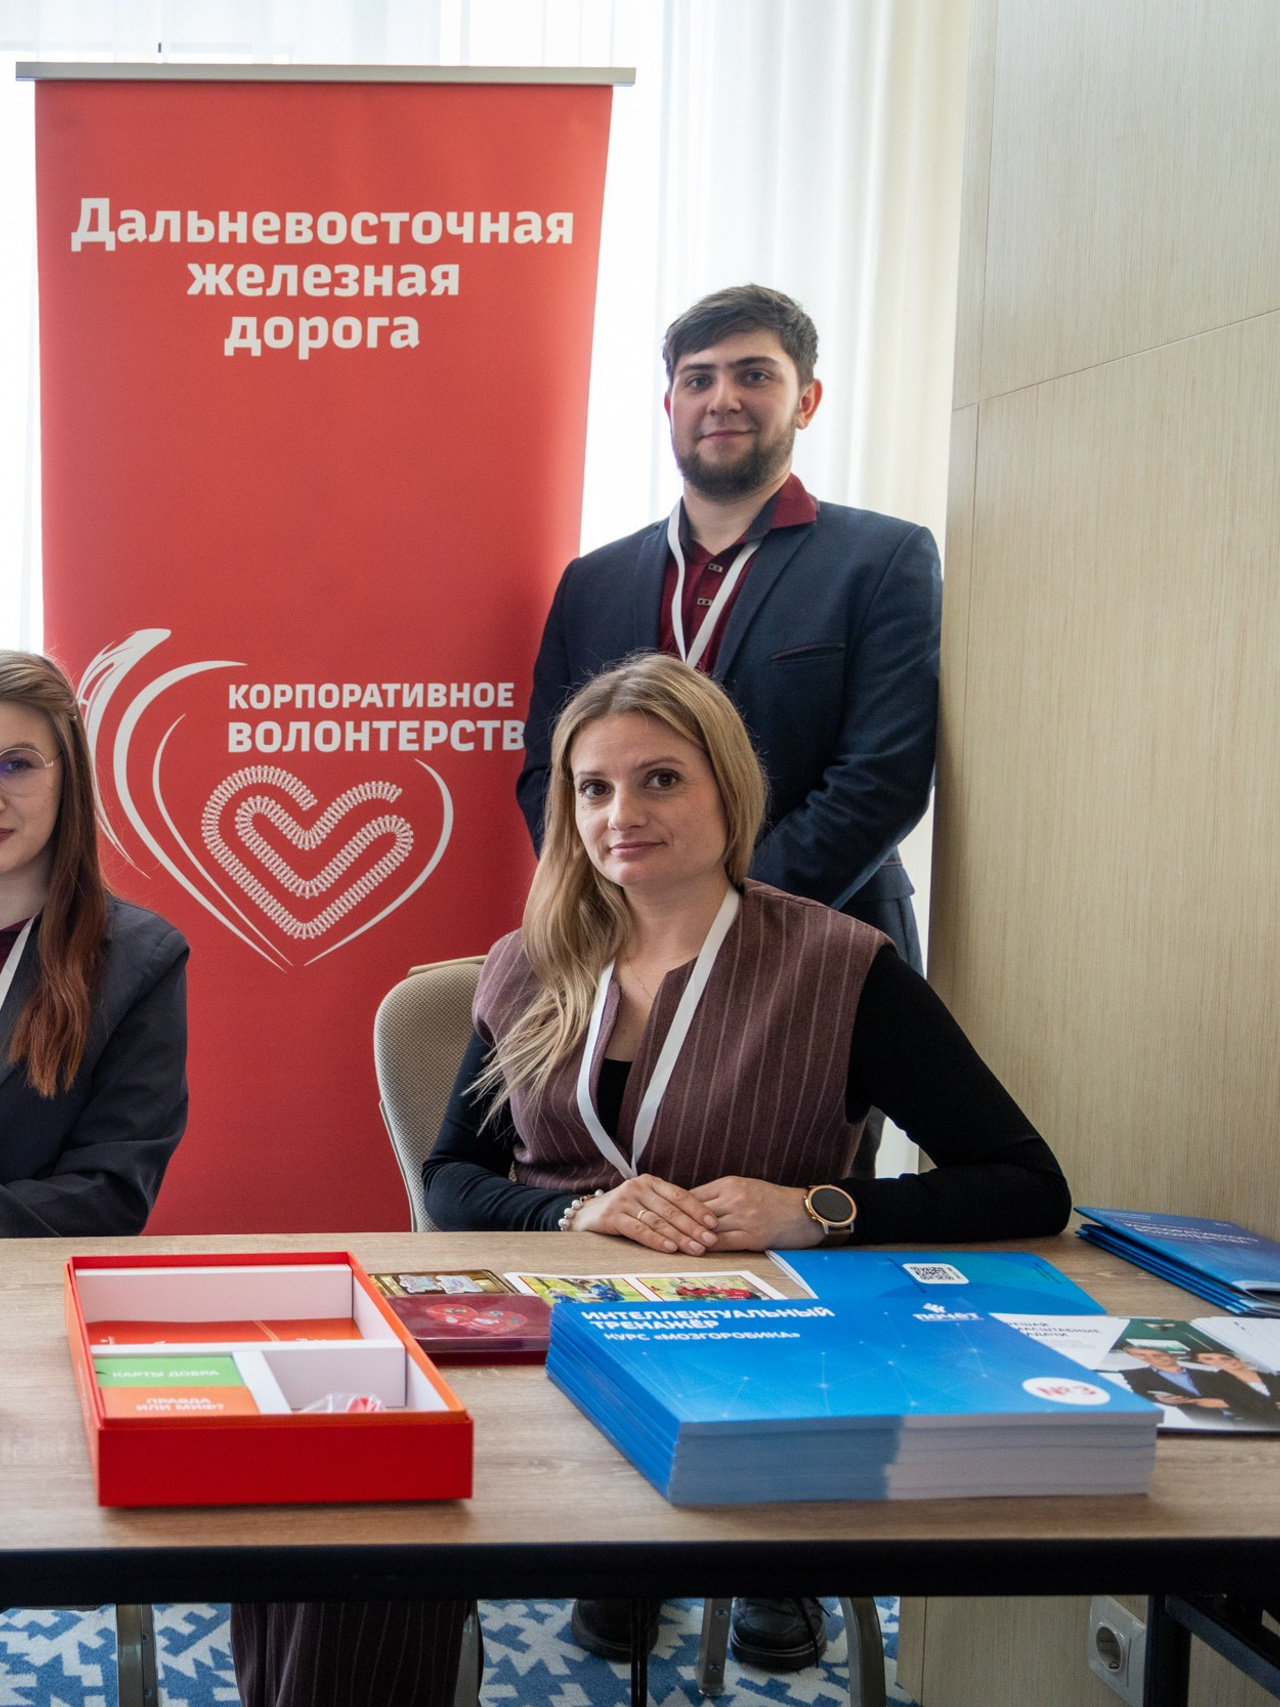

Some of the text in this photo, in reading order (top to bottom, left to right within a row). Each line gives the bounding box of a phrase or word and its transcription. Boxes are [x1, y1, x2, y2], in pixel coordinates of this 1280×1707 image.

[71, 197, 574, 252] Дальневосточная
[186, 262, 460, 297] железная
[224, 315, 420, 360] дорога
[228, 682, 514, 710] КОРПОРАТИВНОЕ
[228, 719, 526, 754] ВОЛОНТЕРСТВ
[580, 1306, 836, 1321] ИНТЕЛЛЕКТУАЛЬНЫЙ
[589, 1318, 720, 1330] ТРЕНАЖЁР
[603, 1332, 651, 1341] КУРС
[168, 1369, 220, 1377] ДОБРА
[145, 1397, 211, 1405] ПРАВДА
